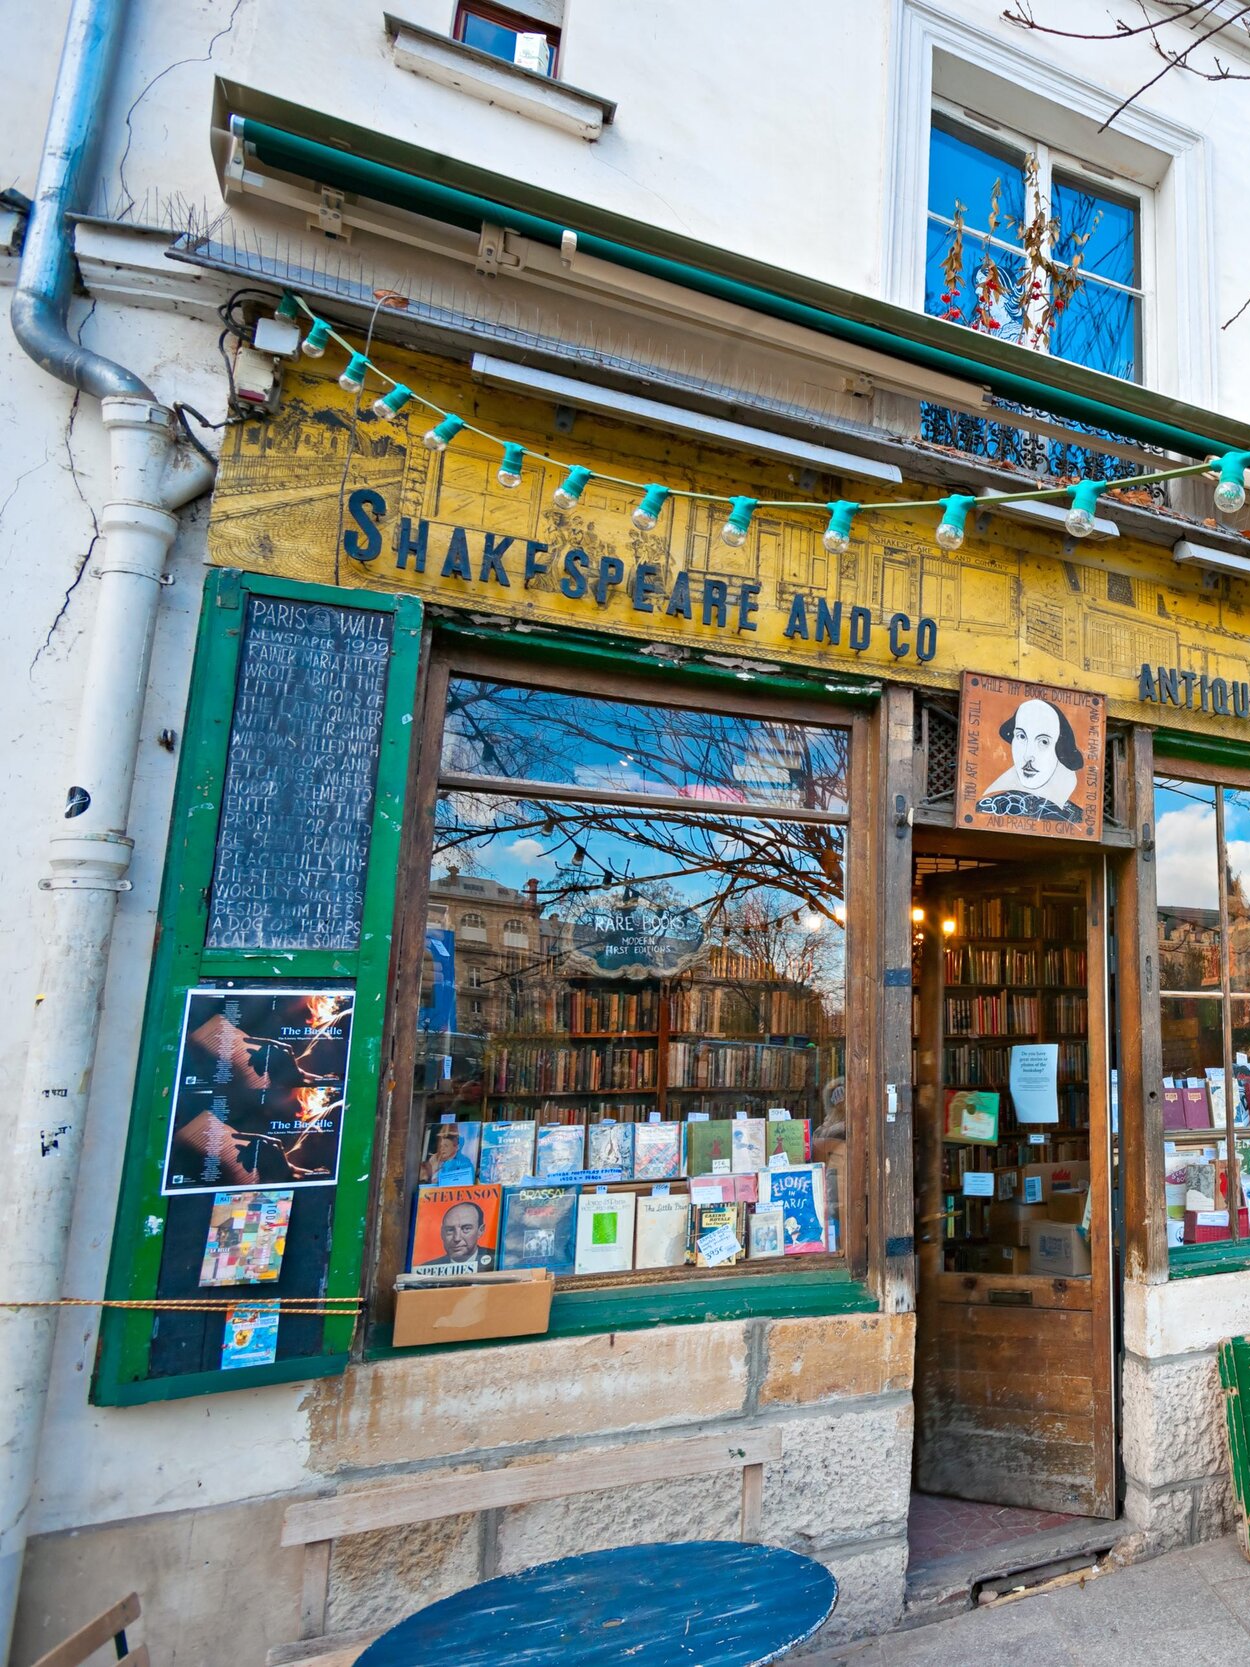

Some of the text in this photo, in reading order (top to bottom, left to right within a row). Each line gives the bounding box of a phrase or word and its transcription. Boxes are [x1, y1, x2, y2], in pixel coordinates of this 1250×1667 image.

[253, 600, 388, 641] PARIS WALL
[784, 593, 871, 650] AND
[890, 612, 937, 662] CO
[249, 628, 389, 656] NEWSPAPER 1999
[249, 643, 386, 677] RAINER MARIA RILKE
[244, 662, 385, 693] WROTE ABOUT THE
[243, 678, 384, 708] LITTLE SHOPS OF
[980, 676, 1091, 707] WHILE THY BOOKE DOTH LIVE
[239, 695, 382, 726] THE LATIN QUARTER
[237, 711, 377, 741] WITH THEIR SHOP
[233, 730, 379, 758] WINDOWS FILLED WITH
[964, 700, 981, 801] THOU ART ALIVE STILL
[231, 747, 371, 773] OLD BOOKS AND
[1085, 705, 1099, 827] AND WE HAVE WITS TO READ
[229, 762, 372, 788] ETCHINGS WHERE
[228, 778, 372, 803] NOBODY SEEMED TO
[334, 802, 367, 821] THE
[986, 816, 1075, 835] AND PRAISE TO GIVE
[222, 830, 244, 849] BE
[303, 835, 368, 856] READING
[220, 851, 341, 871] PEACEFULLY
[218, 866, 359, 889] DIFFERENT TO
[214, 883, 293, 900] WORLDLY
[214, 899, 354, 919] BESIDE HIM LIES
[212, 916, 361, 935] A DOG OR PERHAPS
[594, 914, 685, 932] RARE BOOKS
[209, 932, 217, 947] A
[271, 934, 308, 948] WISH
[605, 945, 671, 955] FIRST EDITIONS
[622, 937, 655, 945] MODERN
[281, 1027, 301, 1035] The
[270, 1121, 291, 1129] The
[497, 1136, 521, 1144] Town
[423, 1187, 499, 1204] STEVENSON
[772, 1175, 811, 1197] ELOISE
[644, 1203, 673, 1212] The Little
[705, 1246, 723, 1260] 395€
[416, 1263, 474, 1276] SPEECHES
